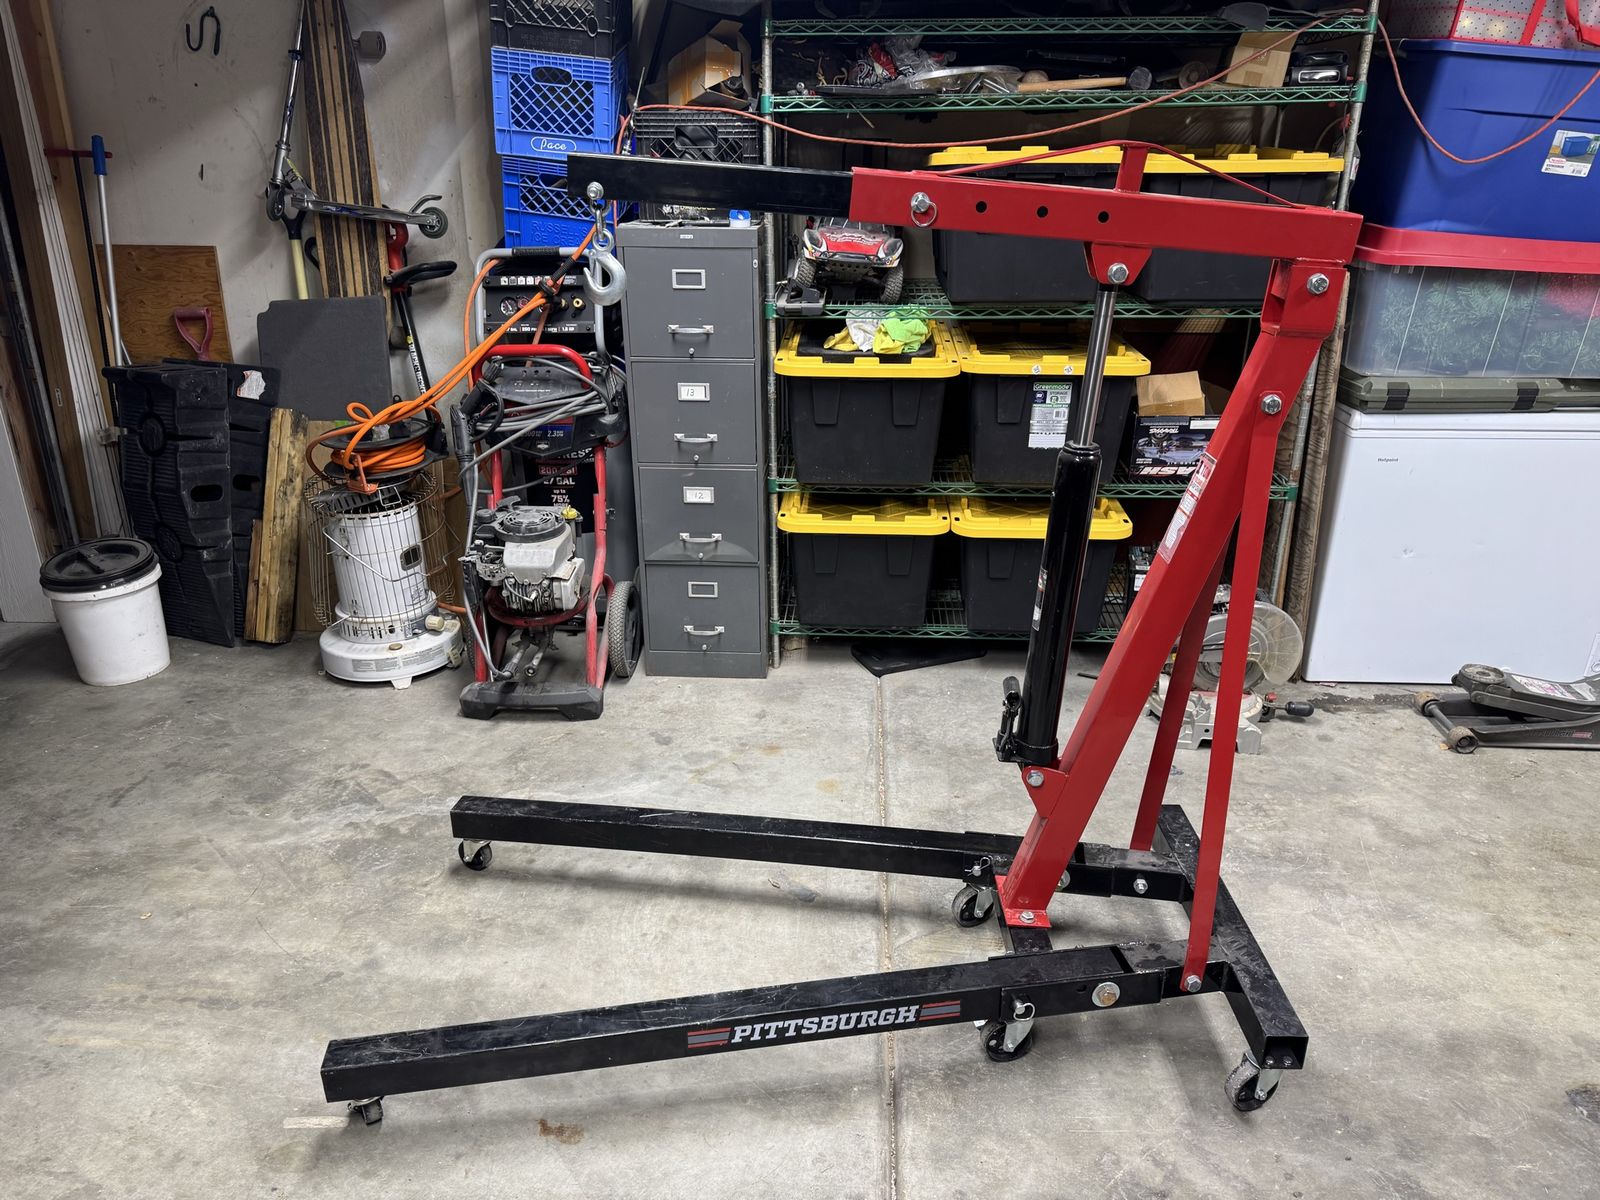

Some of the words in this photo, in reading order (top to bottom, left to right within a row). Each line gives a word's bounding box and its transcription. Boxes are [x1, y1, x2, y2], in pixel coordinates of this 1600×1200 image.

[540, 138, 567, 150] Pace
[686, 388, 695, 397] 13
[556, 477, 576, 485] GAL
[551, 494, 570, 503] 75%
[694, 491, 704, 500] 12
[731, 1005, 919, 1043] PITTSBURGH
